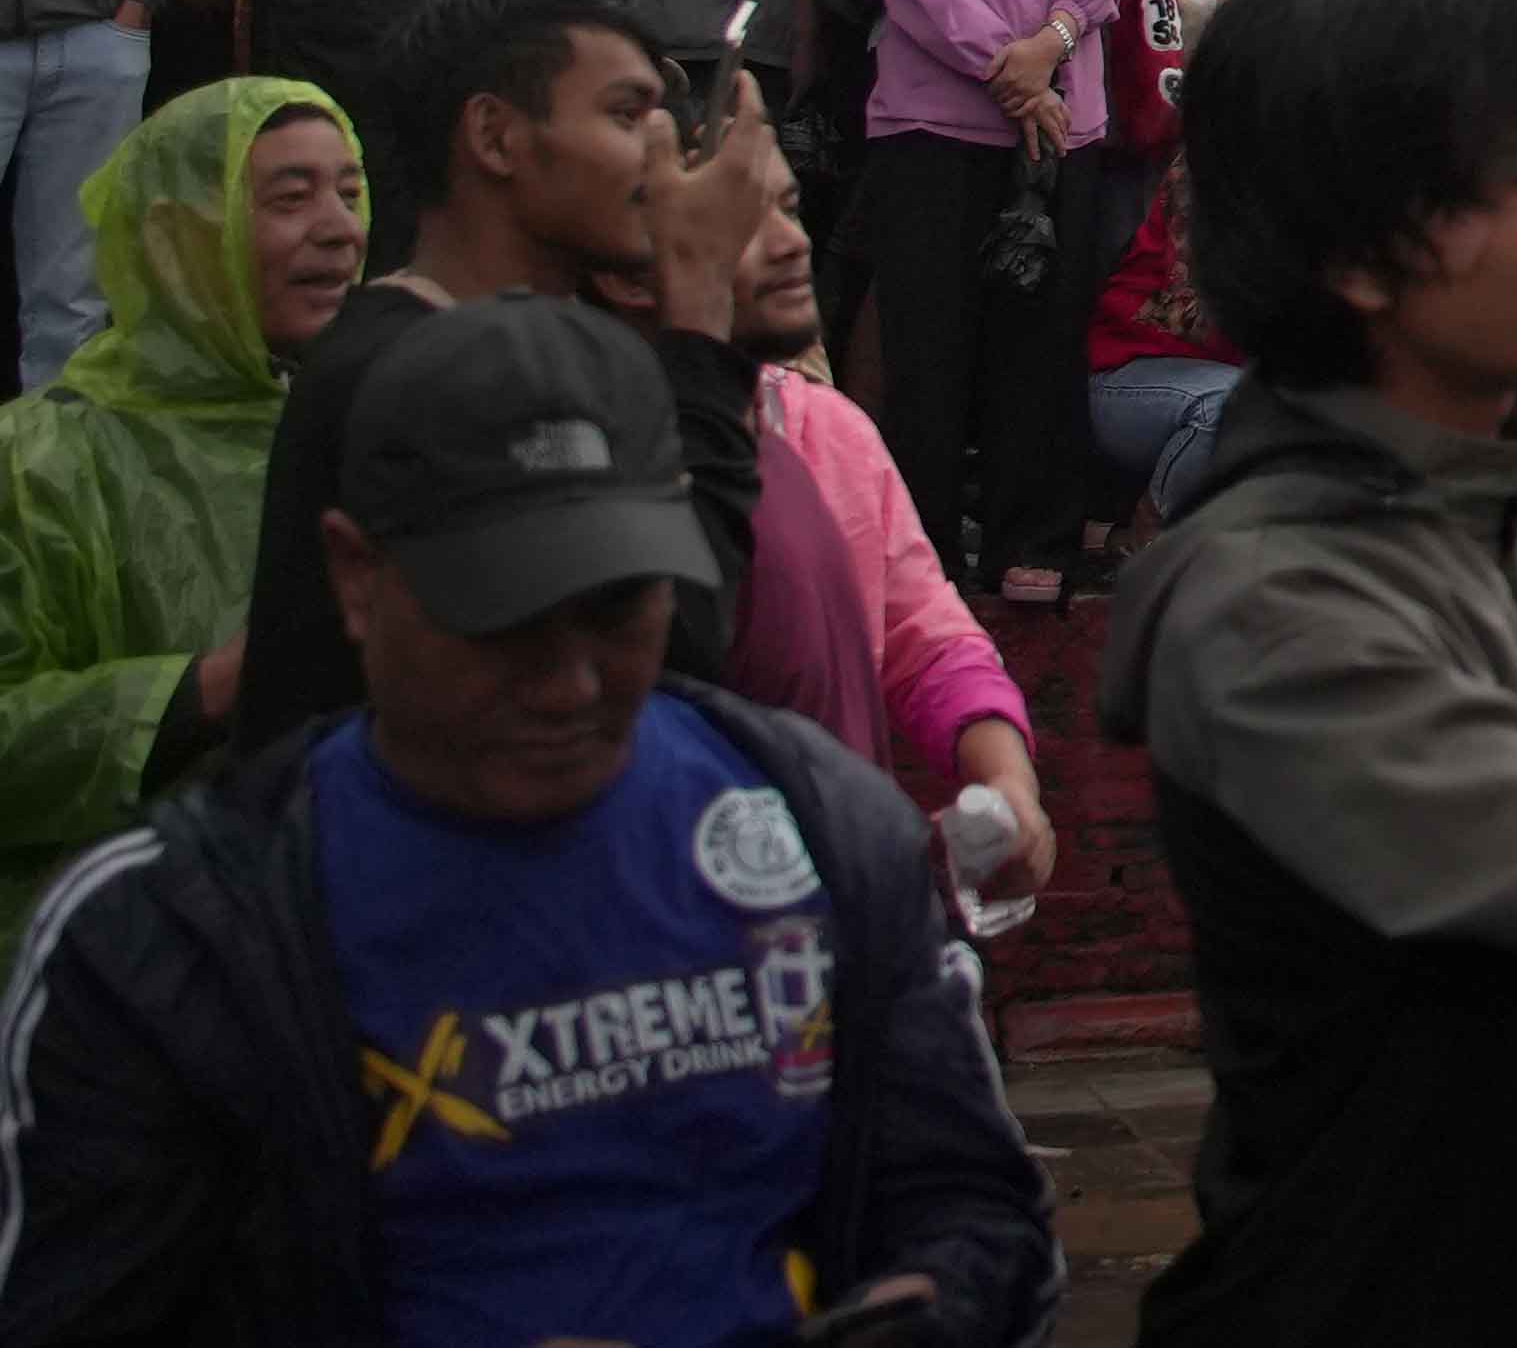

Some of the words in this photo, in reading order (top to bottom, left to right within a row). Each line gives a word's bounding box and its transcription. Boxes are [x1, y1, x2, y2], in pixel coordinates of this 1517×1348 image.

[481, 966, 757, 1085] XTREME
[497, 1059, 653, 1120] ENERGY
[660, 1036, 771, 1082] DRINK
